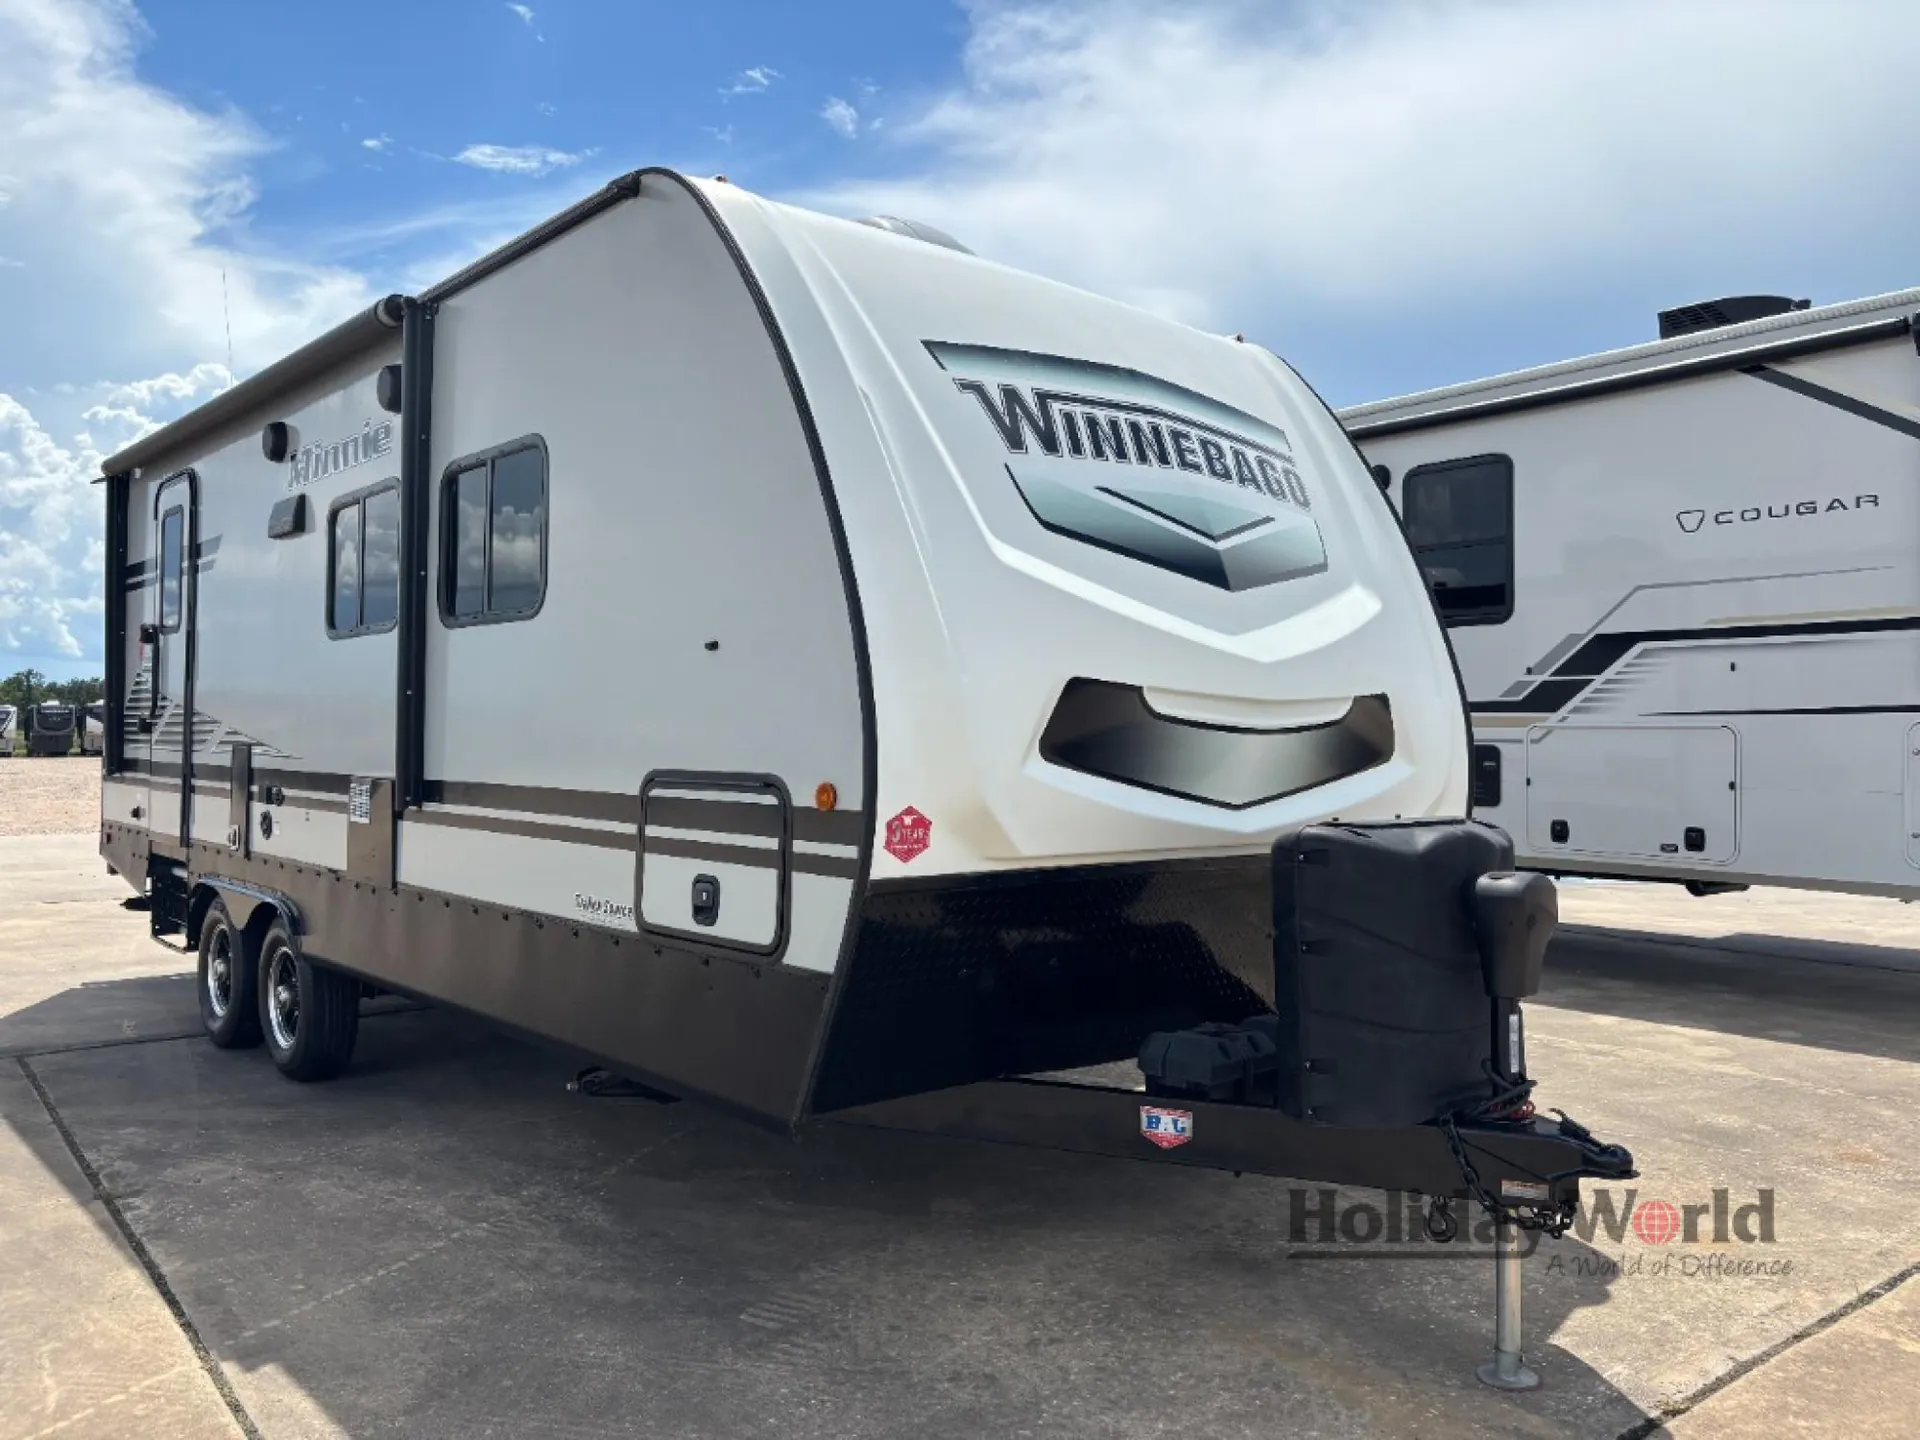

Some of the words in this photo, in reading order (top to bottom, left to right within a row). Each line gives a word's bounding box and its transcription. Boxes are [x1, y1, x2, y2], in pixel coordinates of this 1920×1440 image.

[288, 419, 392, 492] Minnie
[953, 377, 1312, 512] WINNEBAGO
[1714, 494, 1880, 526] COUGAR
